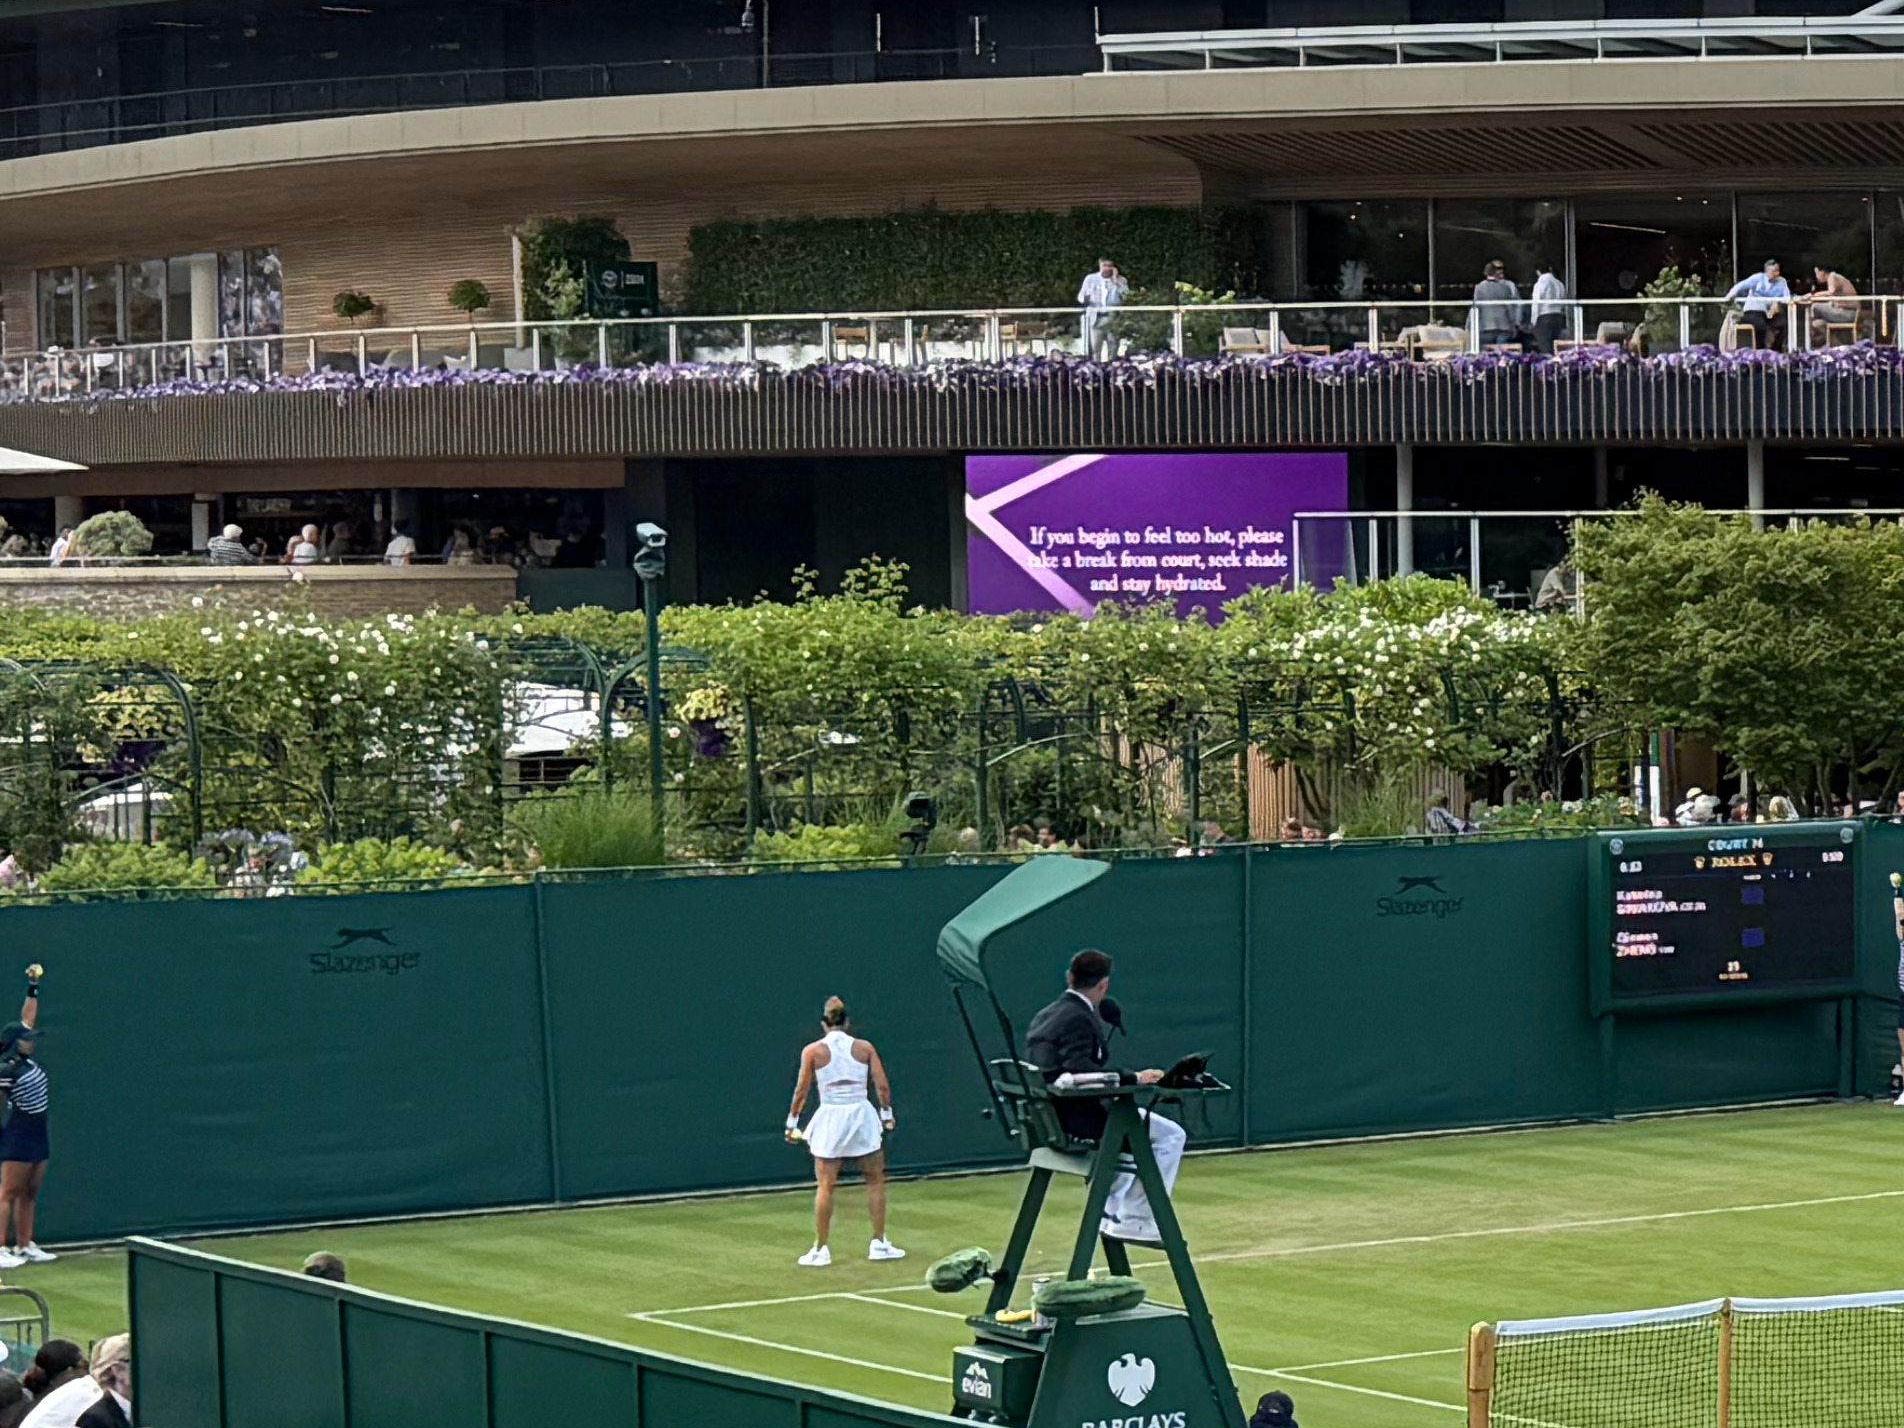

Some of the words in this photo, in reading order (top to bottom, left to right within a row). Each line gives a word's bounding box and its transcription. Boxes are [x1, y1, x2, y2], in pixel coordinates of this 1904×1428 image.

[1029, 526, 1046, 545] If
[1047, 532, 1075, 550] you
[1078, 526, 1121, 550] begin
[1124, 530, 1140, 544] to
[1144, 525, 1172, 544] feel
[1175, 530, 1201, 544] too
[1204, 525, 1236, 547] hot,
[1238, 525, 1284, 549] please
[1062, 555, 1072, 568] a
[1074, 550, 1118, 568] break
[1120, 550, 1157, 568] from
[1161, 554, 1206, 571] court,
[1208, 549, 1242, 568] seek
[1245, 549, 1288, 568] shade
[1090, 573, 1119, 591] and
[1122, 577, 1152, 597] stay
[1155, 572, 1227, 597] hydrated.
[1711, 854, 1757, 868] ROLEX
[309, 952, 421, 976] Slazenger
[961, 1377, 992, 1400] evian
